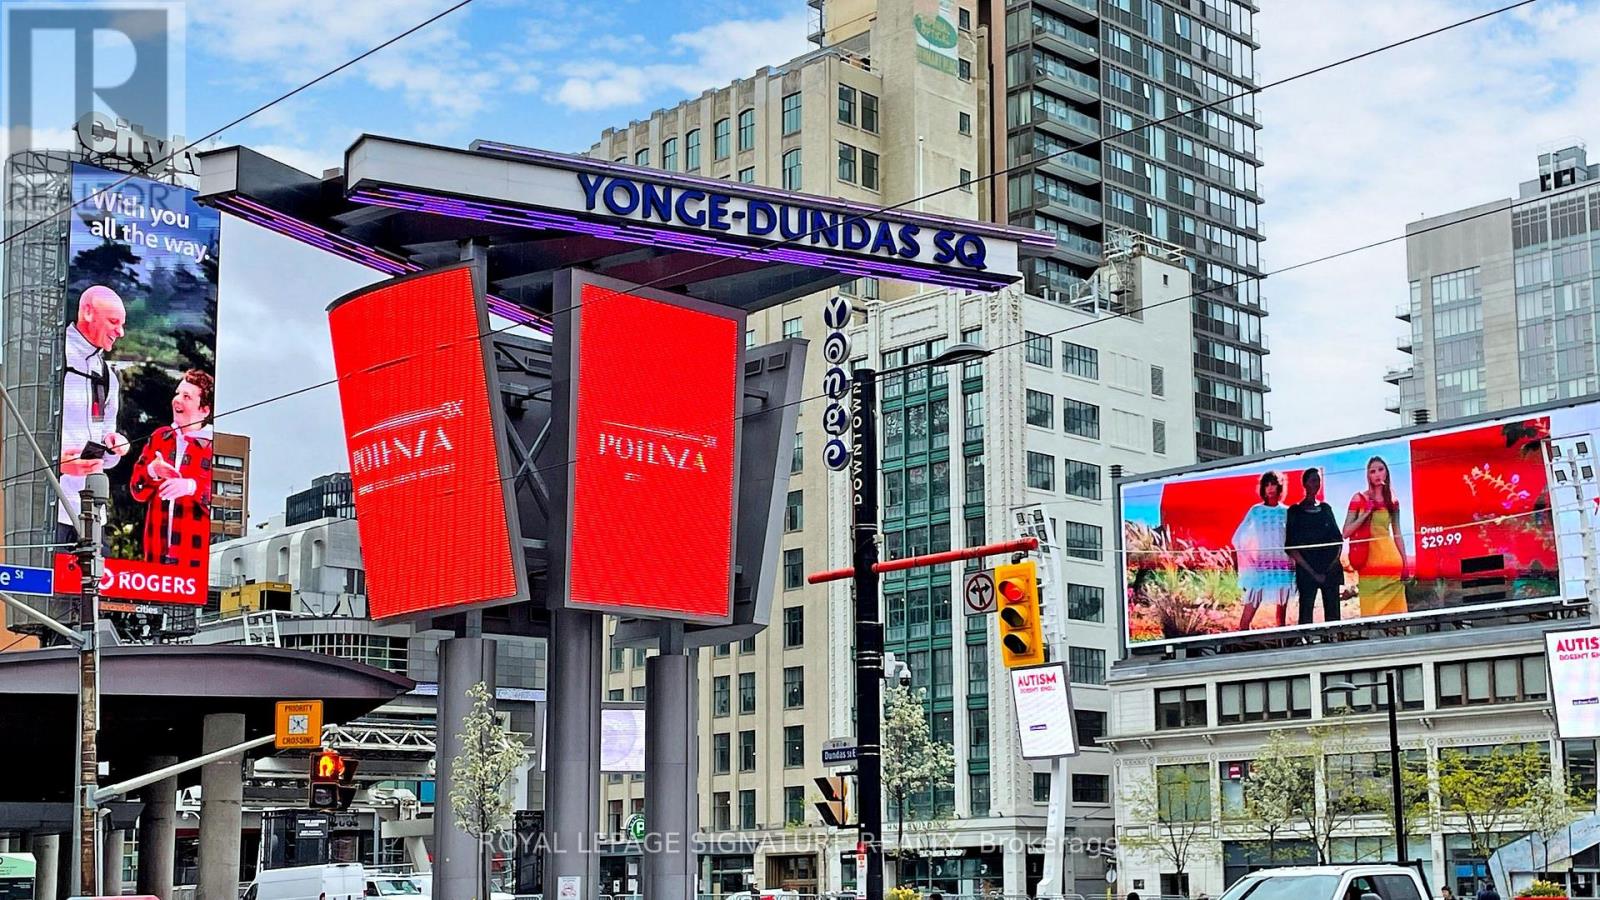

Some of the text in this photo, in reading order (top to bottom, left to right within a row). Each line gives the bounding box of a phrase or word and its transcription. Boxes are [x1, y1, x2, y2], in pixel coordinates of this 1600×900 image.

[93, 187, 190, 229] With you
[578, 173, 987, 270] YONGE-DUNDAS SQ
[91, 217, 210, 263] all the way.
[853, 380, 863, 507] DOWNTOWN
[1421, 532, 1462, 550] $29.99
[15, 570, 24, 579] St
[119, 572, 196, 595] ROGERS
[1018, 672, 1056, 687] AUTISM
[284, 704, 313, 712] PRIORITY
[282, 737, 314, 745] CROSSING
[824, 750, 846, 760] Dundas
